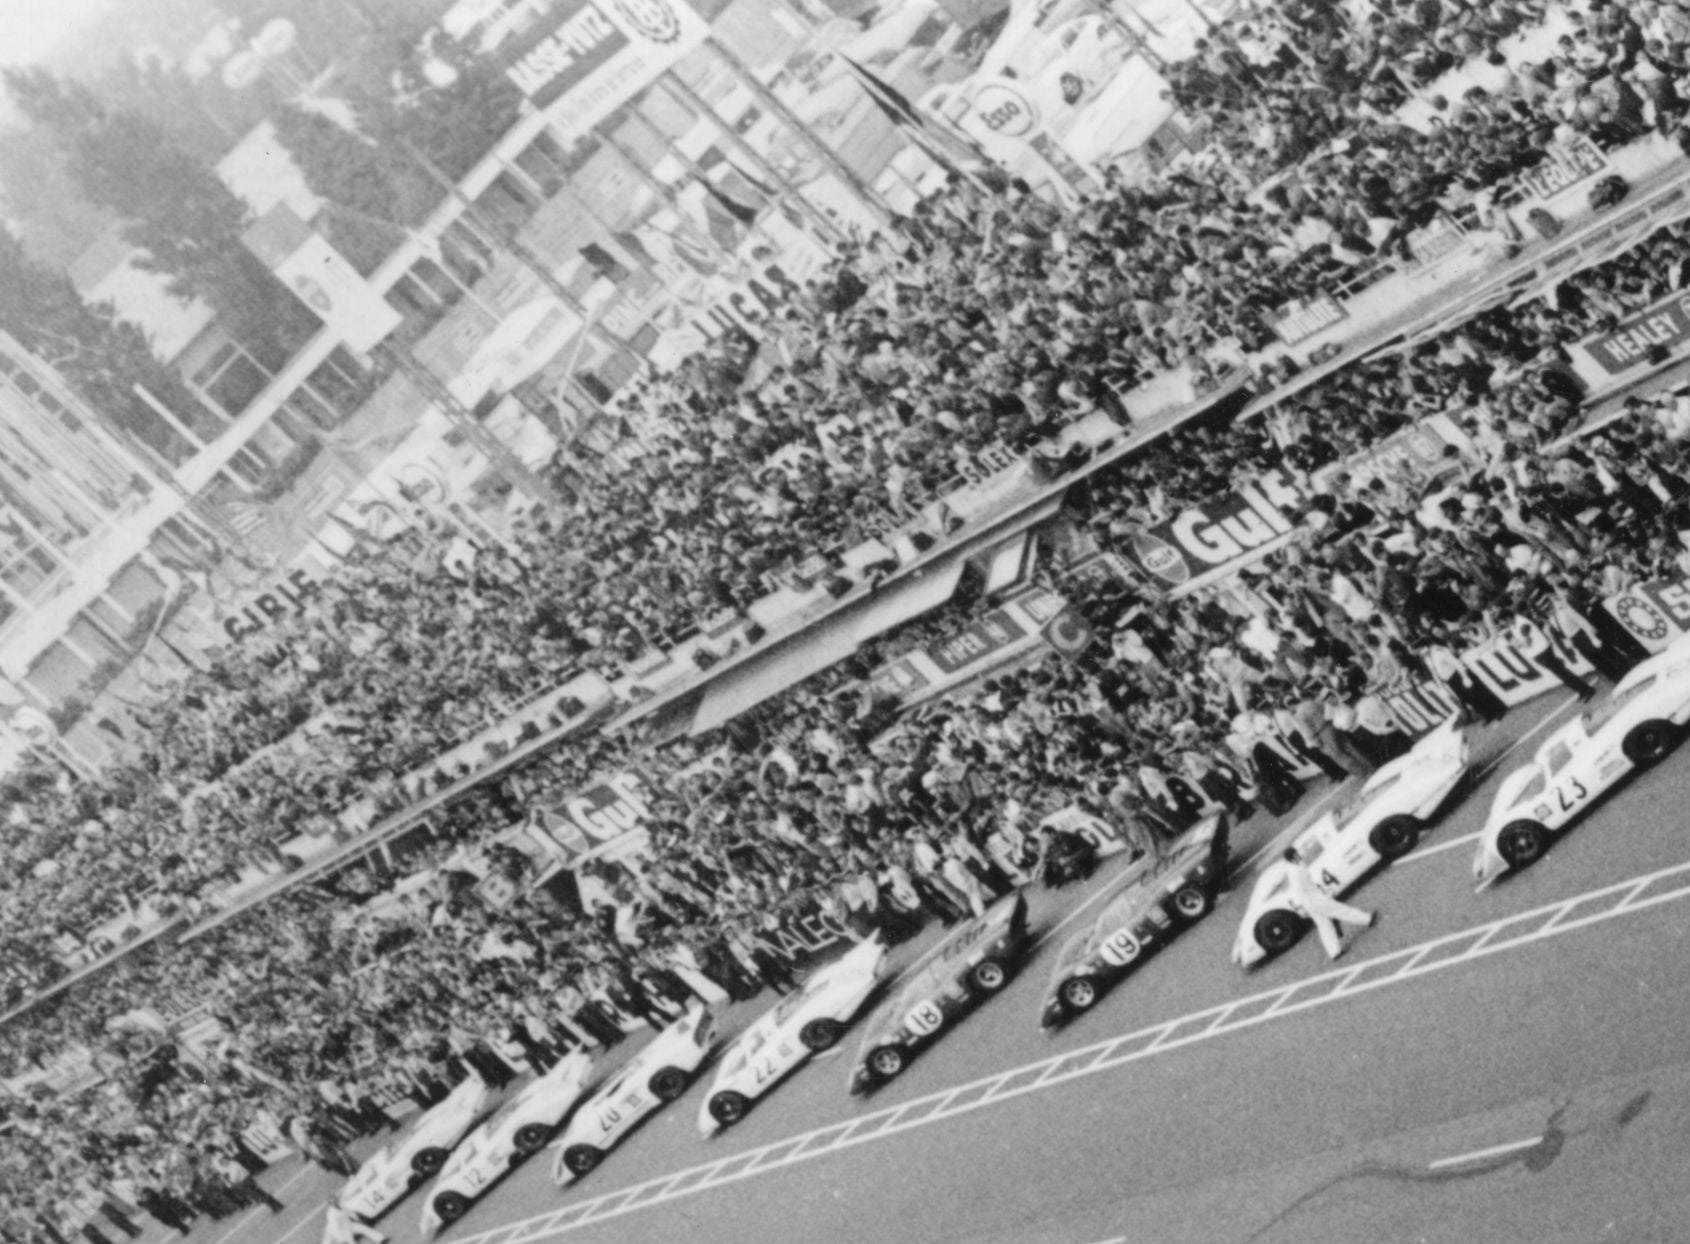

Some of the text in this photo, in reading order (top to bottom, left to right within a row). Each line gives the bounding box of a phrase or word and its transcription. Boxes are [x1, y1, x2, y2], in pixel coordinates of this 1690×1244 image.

[1603, 312, 1680, 362] HEALEY
[1171, 471, 1304, 564] Gulf
[1146, 546, 1177, 568] Gulf
[1051, 612, 1087, 650] C
[1552, 776, 1589, 812] 23
[480, 873, 515, 905] B
[1106, 933, 1137, 958] 19
[911, 1005, 941, 1033] 18
